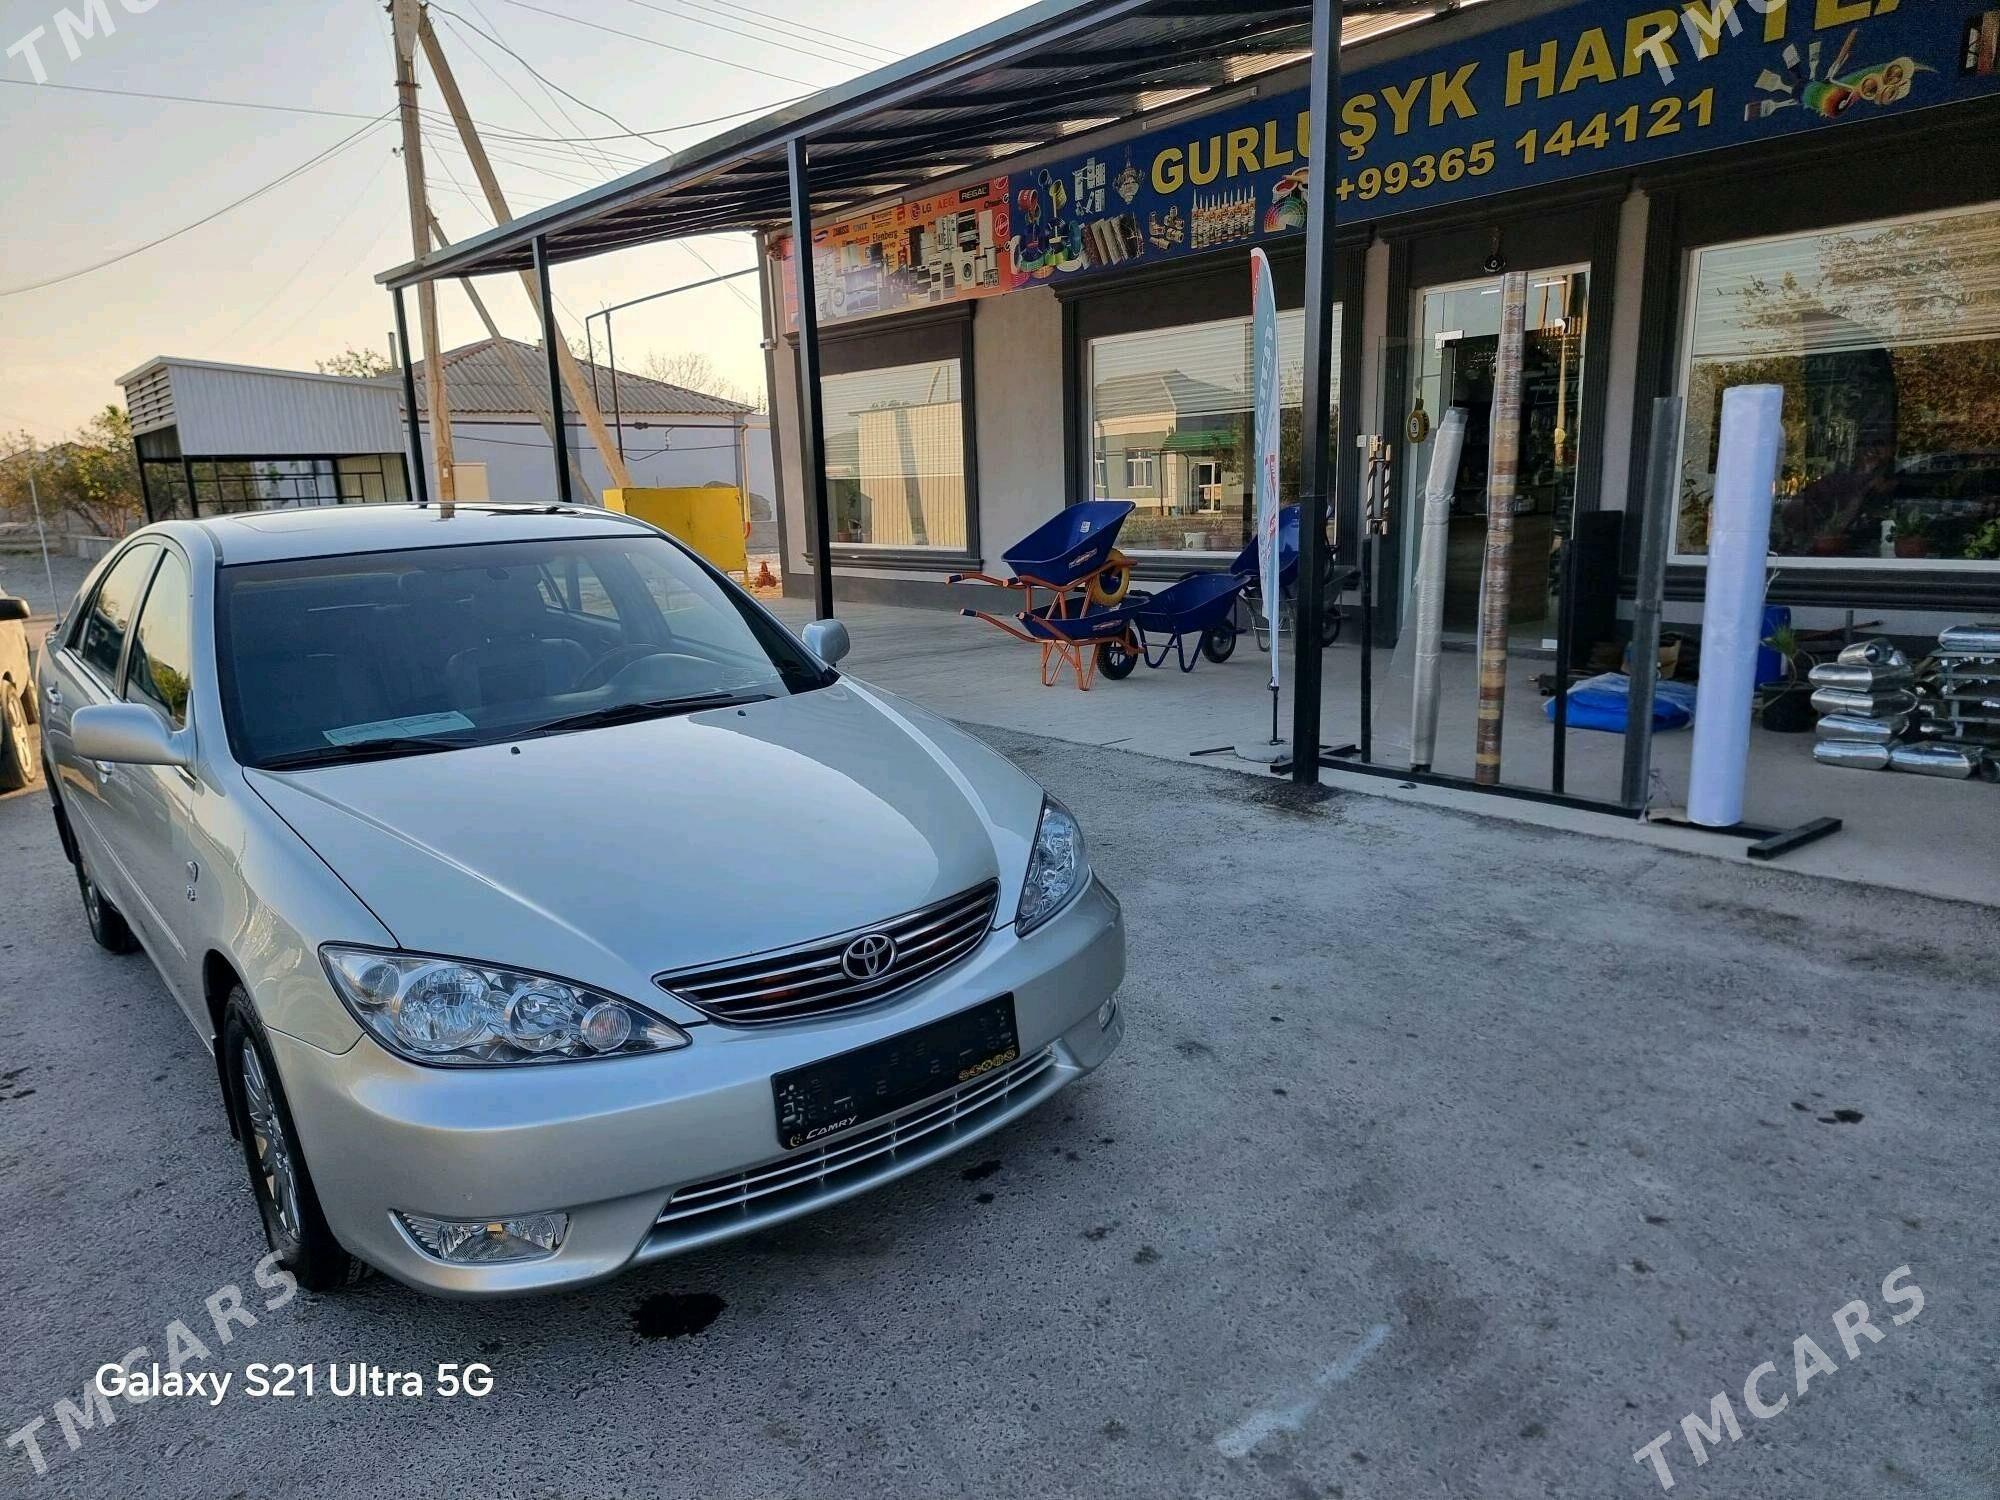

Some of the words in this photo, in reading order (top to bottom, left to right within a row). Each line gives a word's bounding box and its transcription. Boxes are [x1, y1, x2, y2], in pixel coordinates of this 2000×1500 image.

[1336, 139, 1495, 202] +99365
[1514, 87, 1716, 165] 144121
[961, 186, 987, 200] REGAL
[922, 203, 932, 213] LG
[937, 196, 955, 210] AEG
